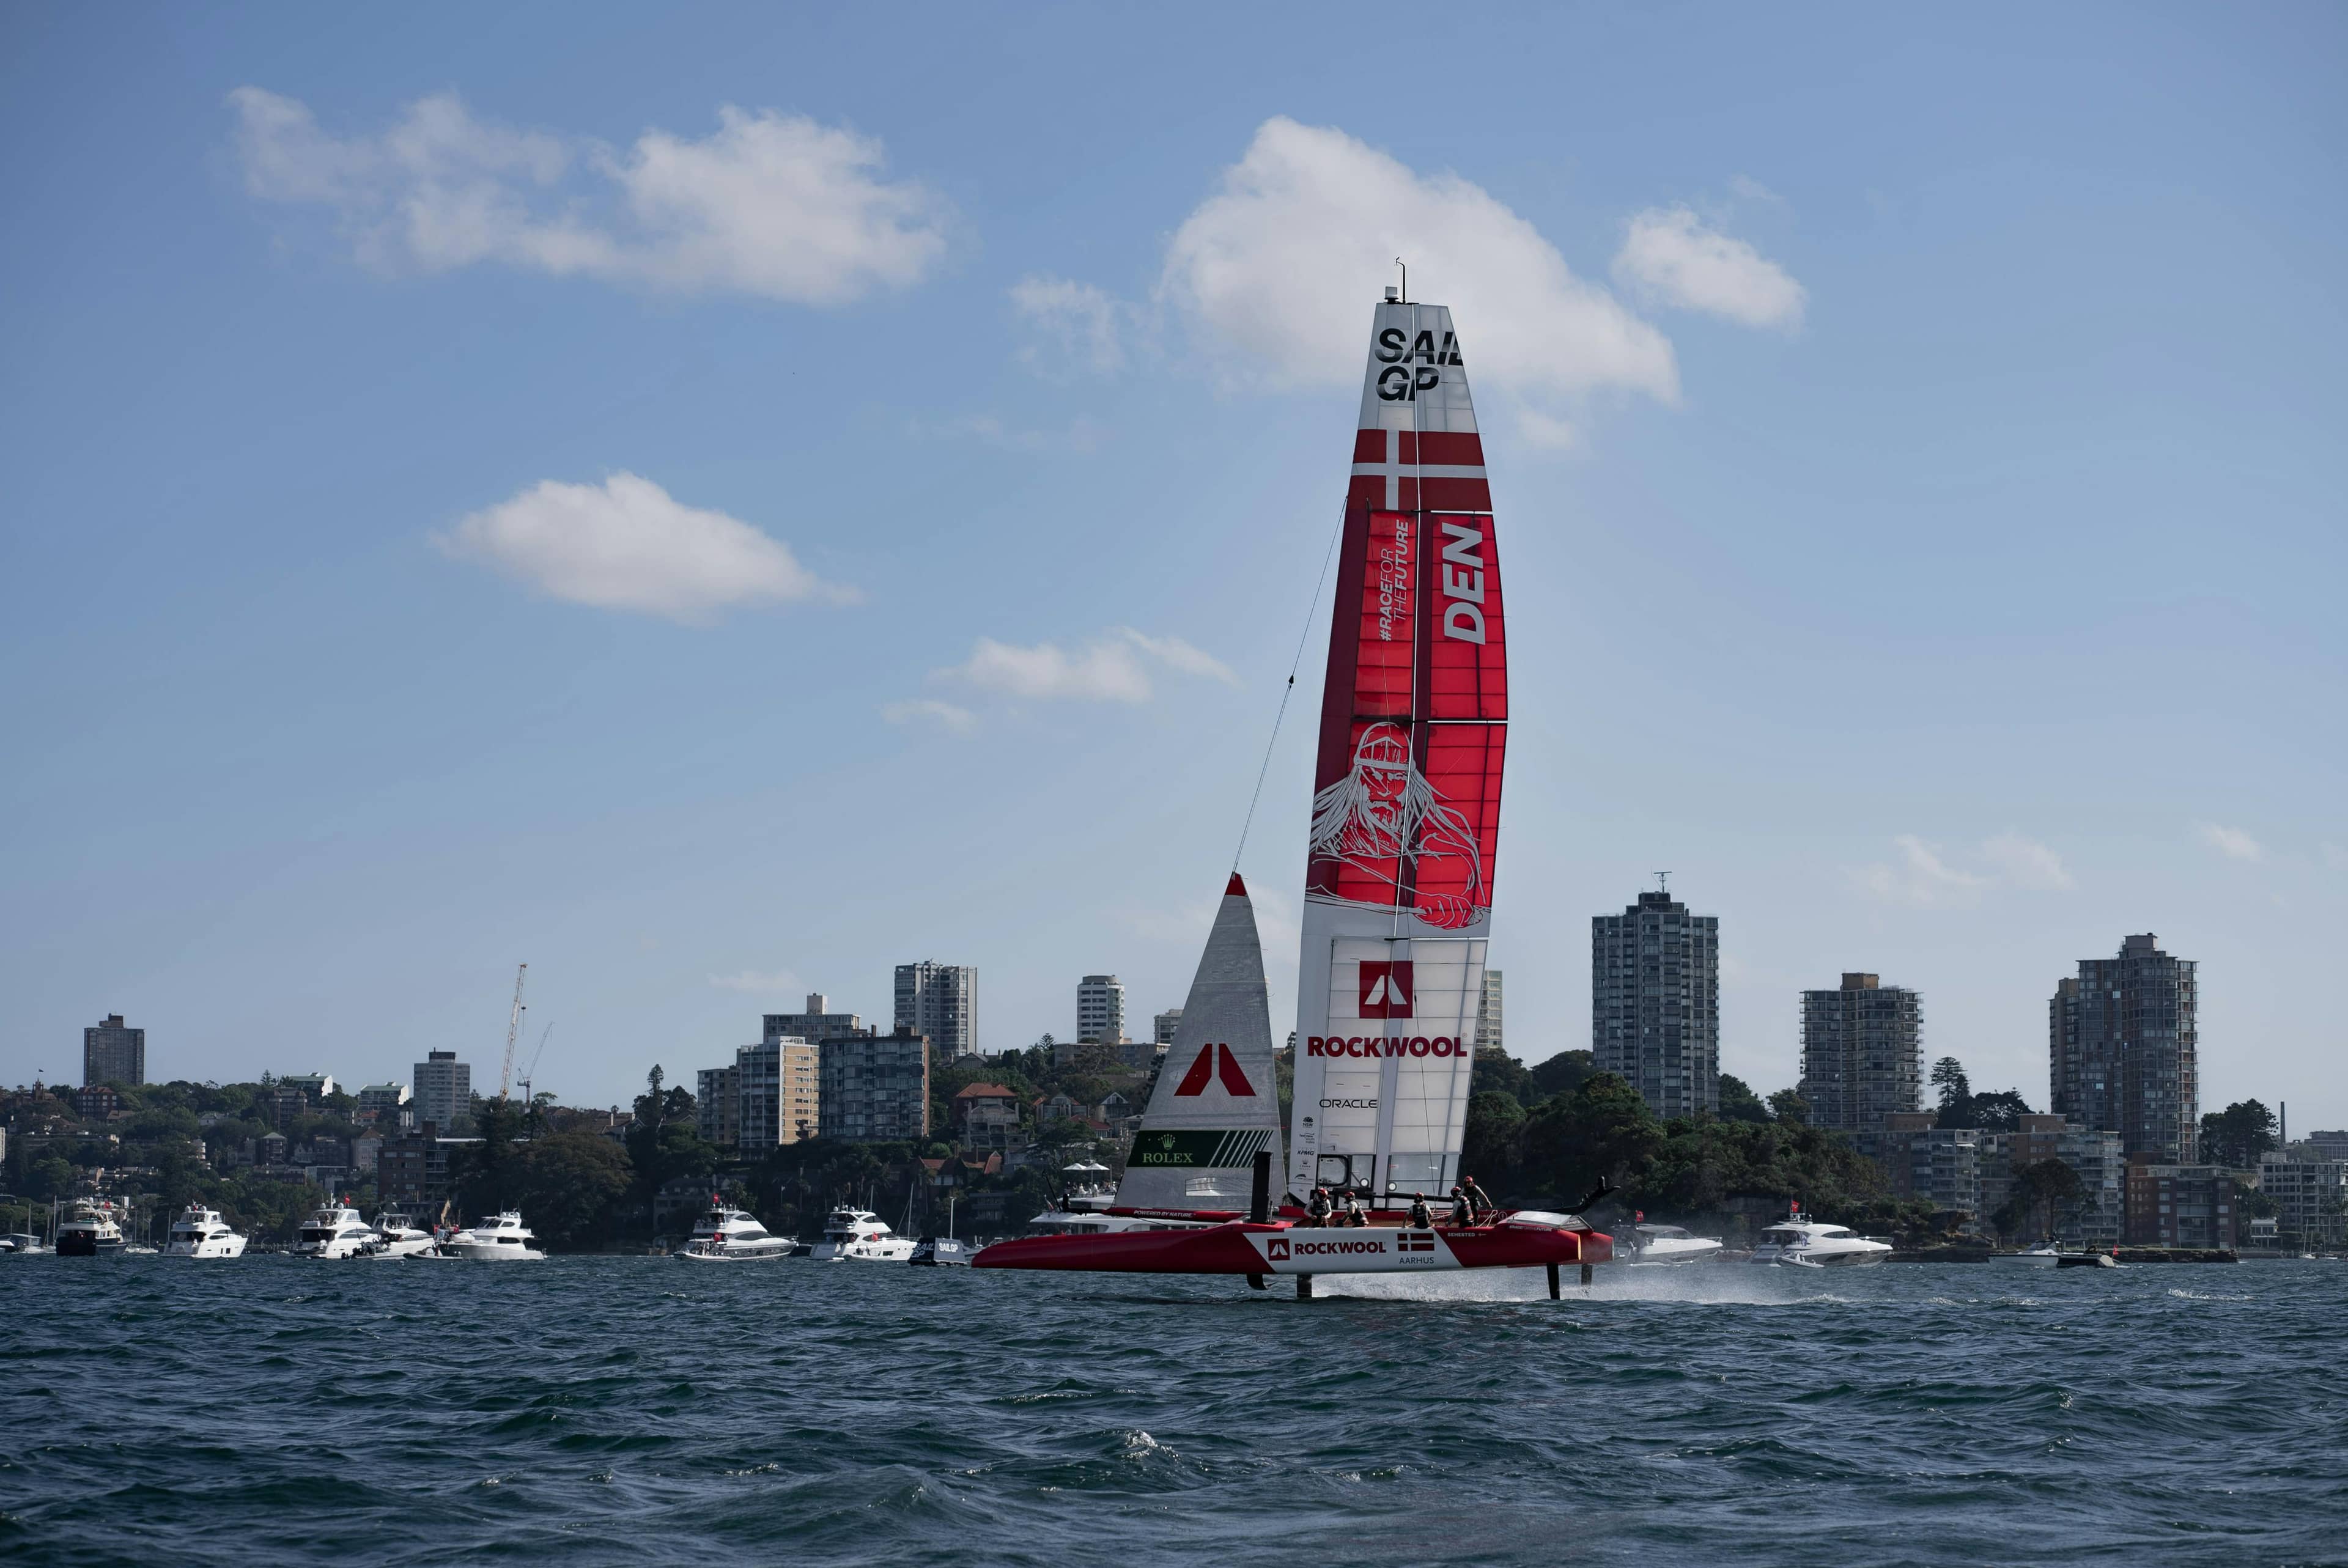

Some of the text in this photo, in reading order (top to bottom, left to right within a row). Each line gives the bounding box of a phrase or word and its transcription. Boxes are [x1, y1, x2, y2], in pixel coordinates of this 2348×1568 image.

[1376, 366, 1439, 401] GP
[1442, 522, 1486, 646] DEN
[1307, 1036, 1468, 1058] ROCKWOOL
[1319, 1099, 1378, 1108] ORACLE
[1142, 1153, 1194, 1163] ROLEX
[1294, 1242, 1387, 1254] ROCKWOOL
